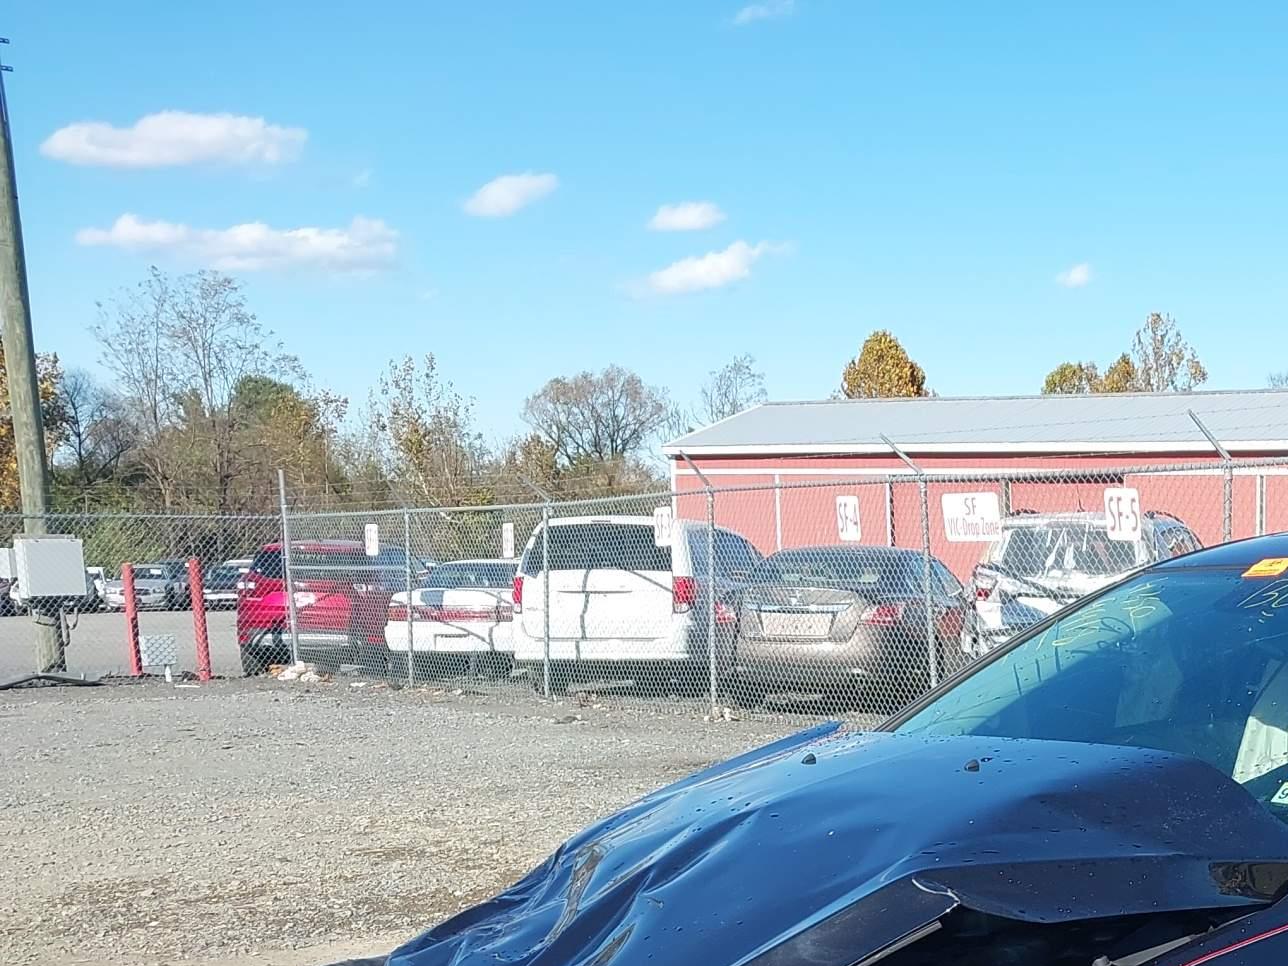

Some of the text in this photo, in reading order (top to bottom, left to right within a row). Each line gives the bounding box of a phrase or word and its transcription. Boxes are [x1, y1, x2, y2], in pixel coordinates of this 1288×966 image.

[963, 497, 977, 515] SF
[1107, 496, 1139, 532] SF-5
[980, 519, 1000, 536] Zone
